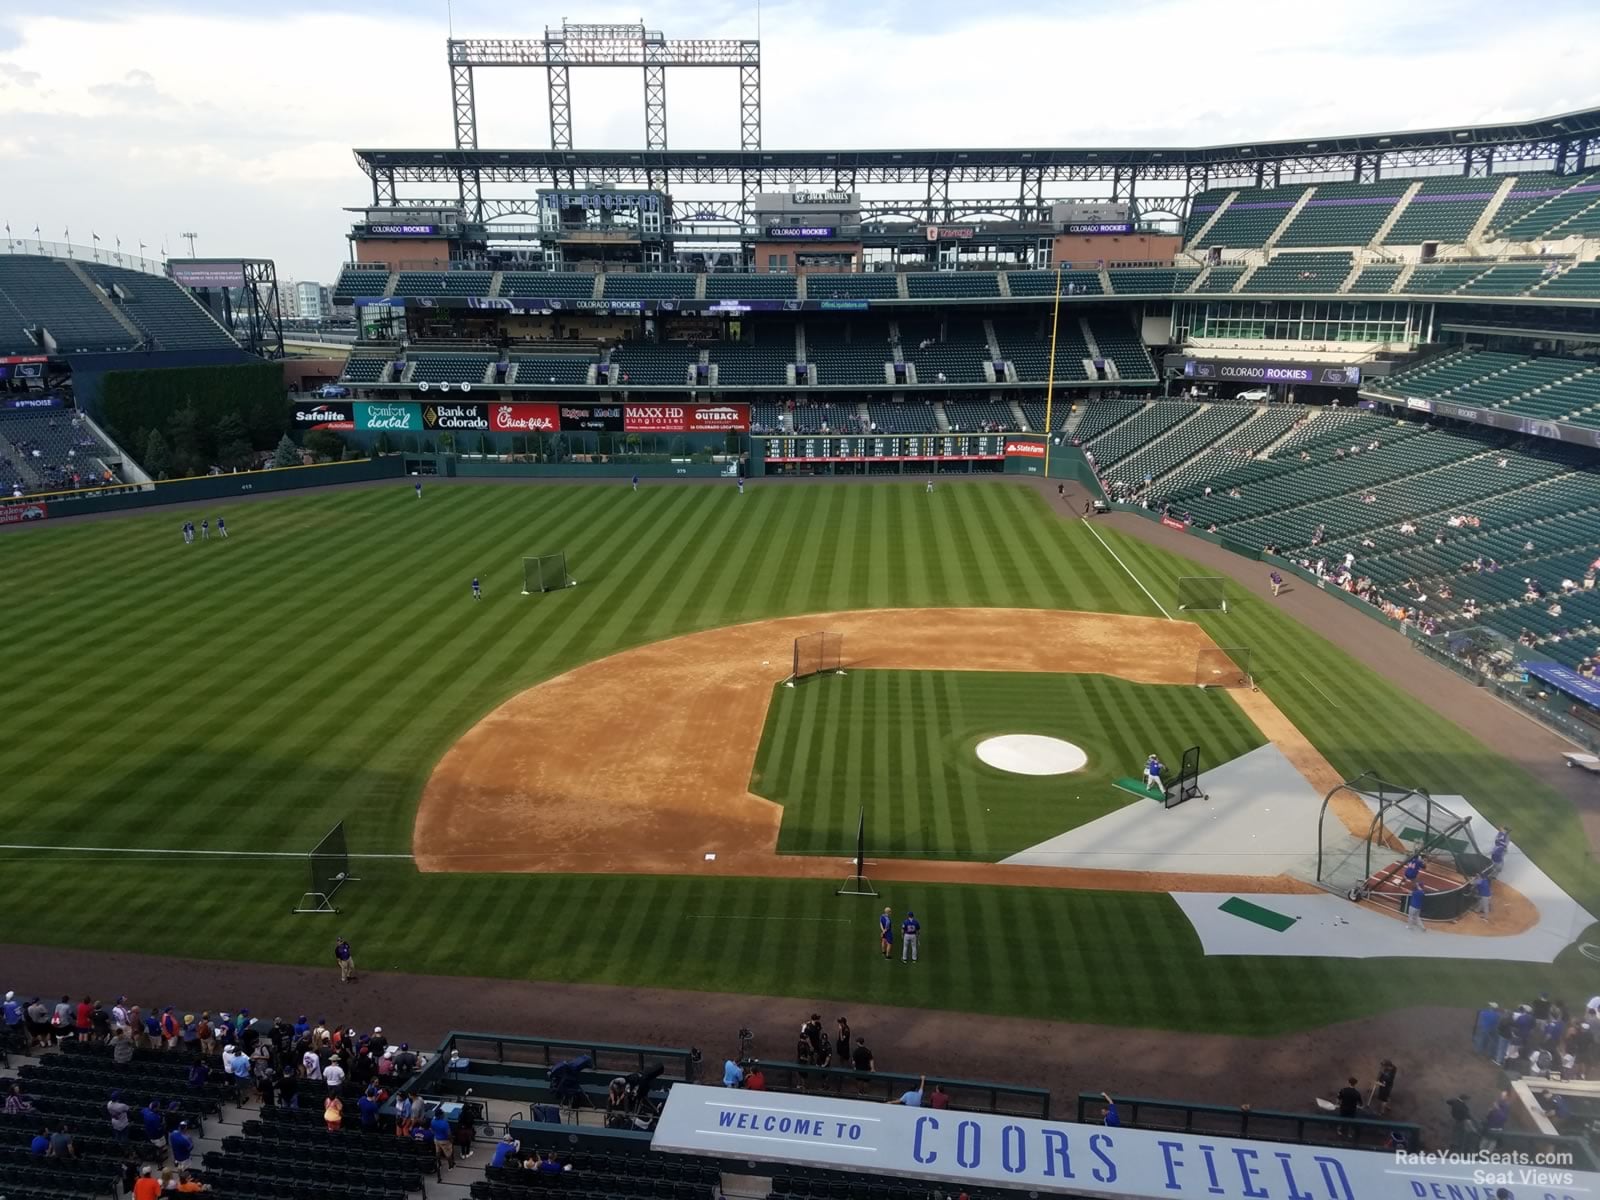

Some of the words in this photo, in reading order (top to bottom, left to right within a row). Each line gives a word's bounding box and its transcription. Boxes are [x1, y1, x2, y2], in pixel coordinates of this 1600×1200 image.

[807, 192, 824, 200] JACK
[539, 194, 569, 208] THE
[580, 194, 659, 211] ROOFTOP
[371, 225, 402, 234] COLORADO
[402, 225, 430, 234] ROCKIES
[771, 228, 800, 236] COLORADO
[801, 228, 828, 236] ROCKIES
[1069, 224, 1099, 233] COLORADO
[1100, 224, 1126, 232] ROCKIES
[576, 301, 610, 309] COLORADO
[611, 301, 641, 309] ROCKIES
[1221, 366, 1264, 378] COLORADO
[1267, 368, 1308, 380] ROCKIES
[296, 411, 345, 421] Safelite
[368, 405, 405, 417] Comfort
[438, 406, 464, 417] Bank
[466, 406, 477, 417] of
[626, 408, 665, 418] MAXX
[665, 408, 684, 418] HD
[368, 413, 410, 429] dental
[695, 412, 739, 421] OUTBACK
[439, 417, 488, 428] Colorado
[719, 1111, 823, 1137] WELCOME
[835, 1122, 863, 1141] TO
[912, 1115, 1118, 1184] COORS
[1157, 1140, 1356, 1200] FIELD
